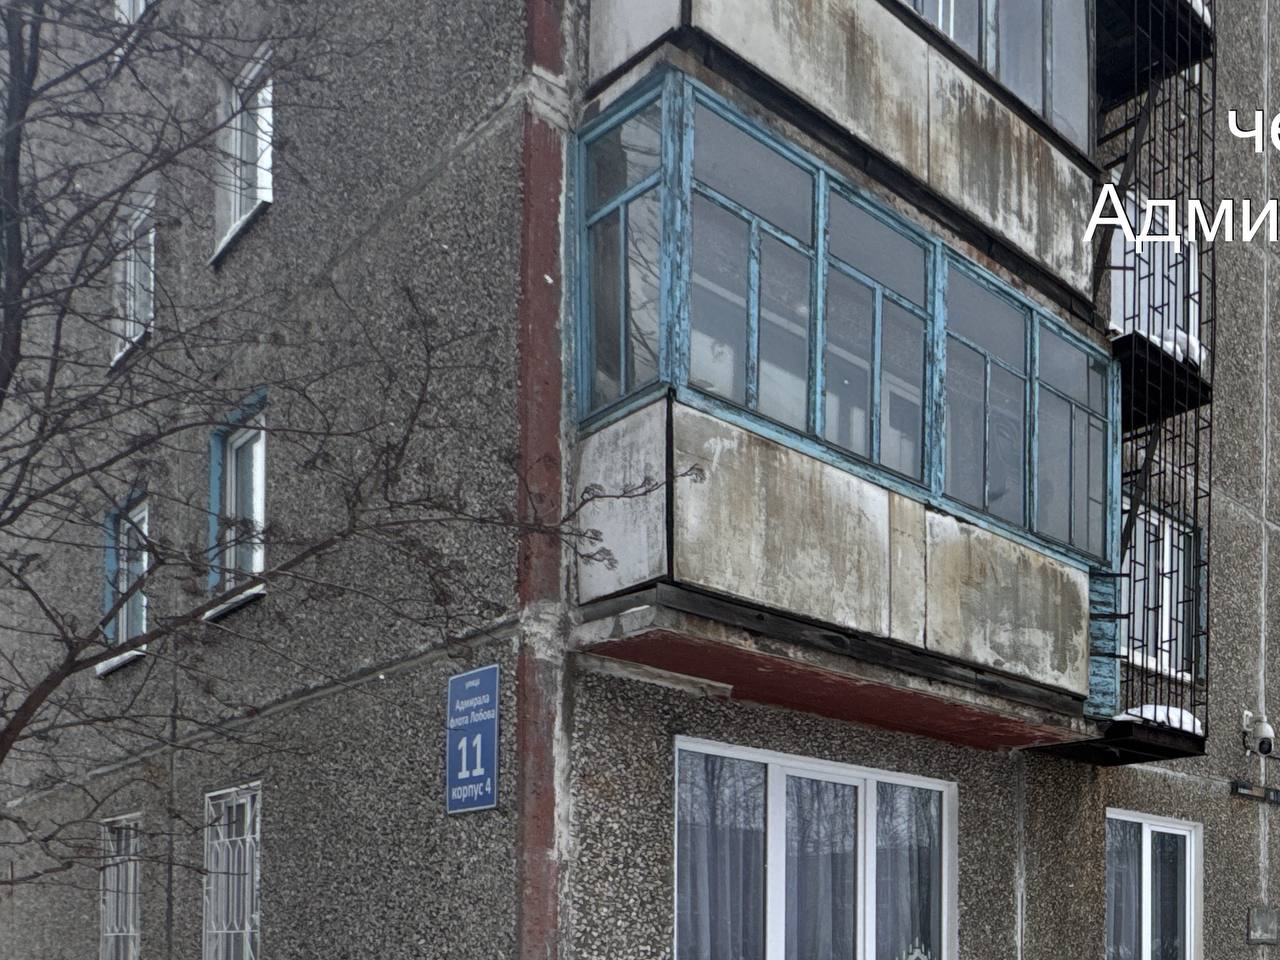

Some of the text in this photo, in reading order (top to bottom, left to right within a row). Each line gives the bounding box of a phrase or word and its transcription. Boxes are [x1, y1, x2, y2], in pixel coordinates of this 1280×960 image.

[455, 694, 490, 711] Адмирала
[470, 708, 496, 724] Лобова
[457, 734, 485, 780] 11
[451, 778, 492, 803] корпус 4
